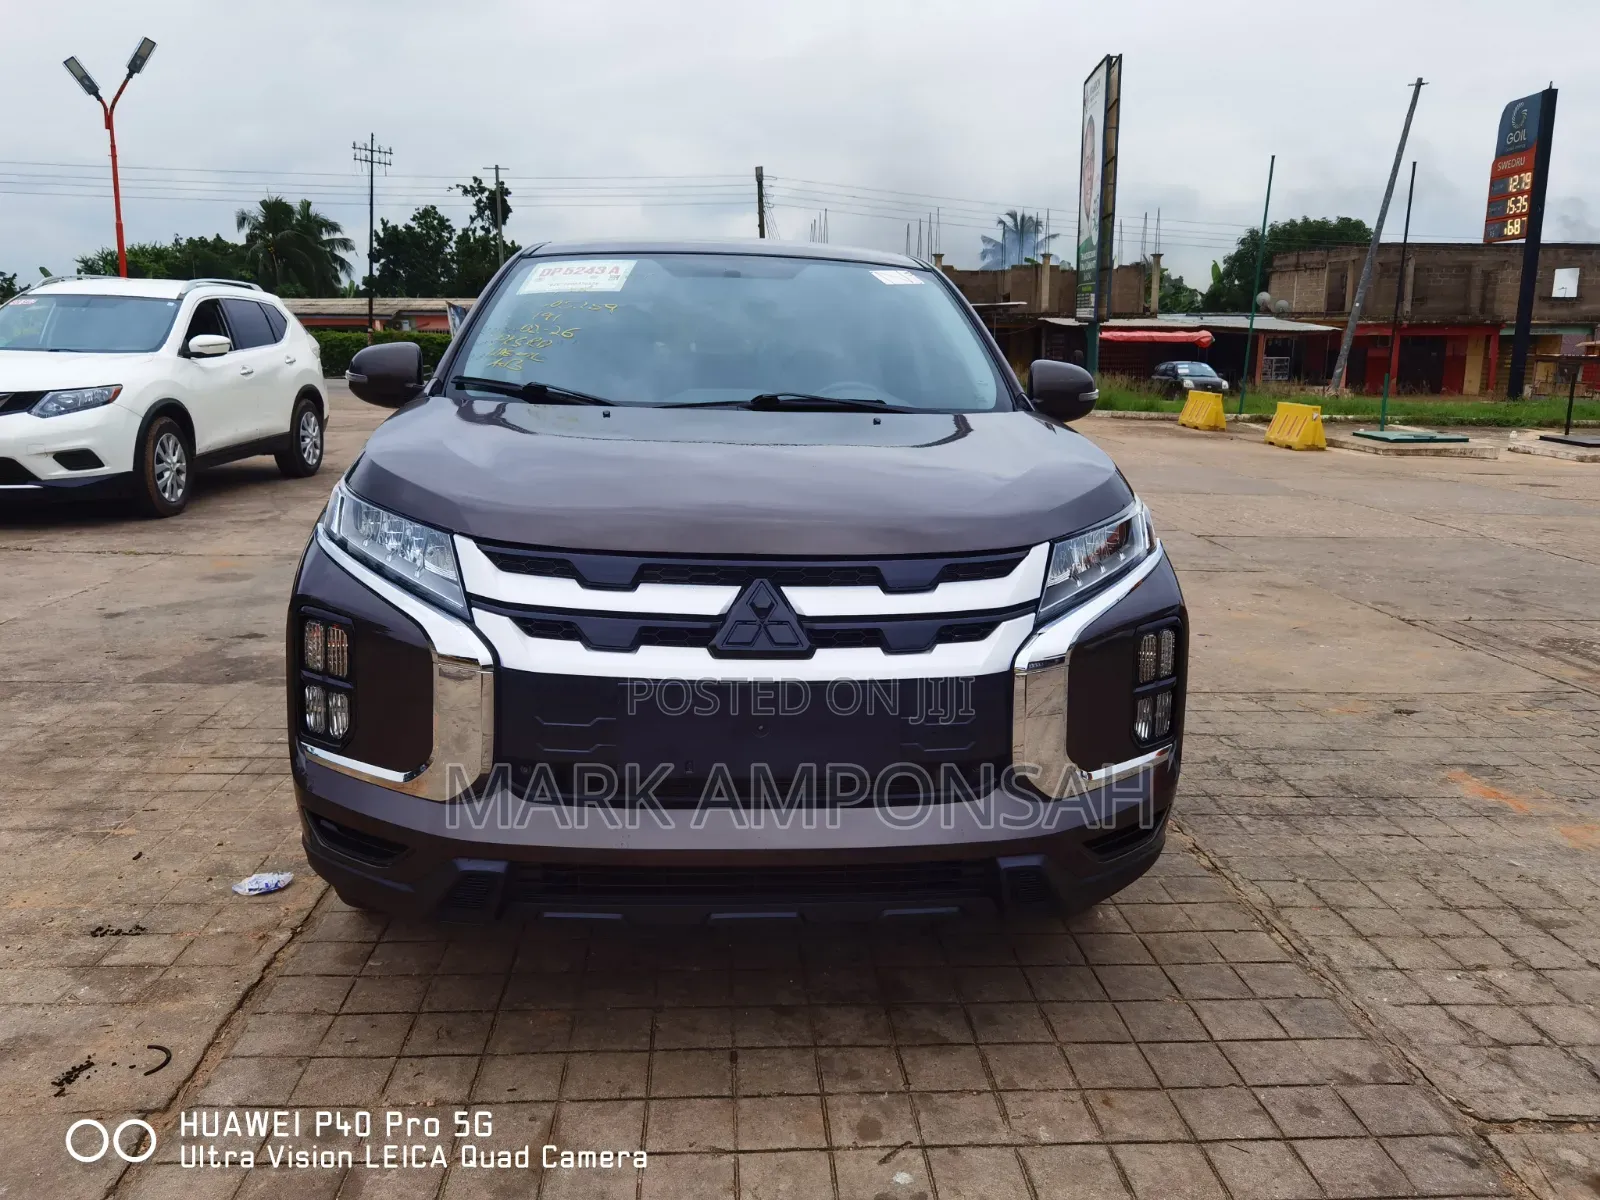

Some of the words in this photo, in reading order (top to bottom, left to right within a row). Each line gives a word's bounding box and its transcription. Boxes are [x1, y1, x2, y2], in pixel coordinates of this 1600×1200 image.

[1506, 129, 1527, 145] GOIL
[1497, 156, 1526, 171] SWEDRU
[562, 266, 605, 275] 5243
[608, 265, 620, 275] A
